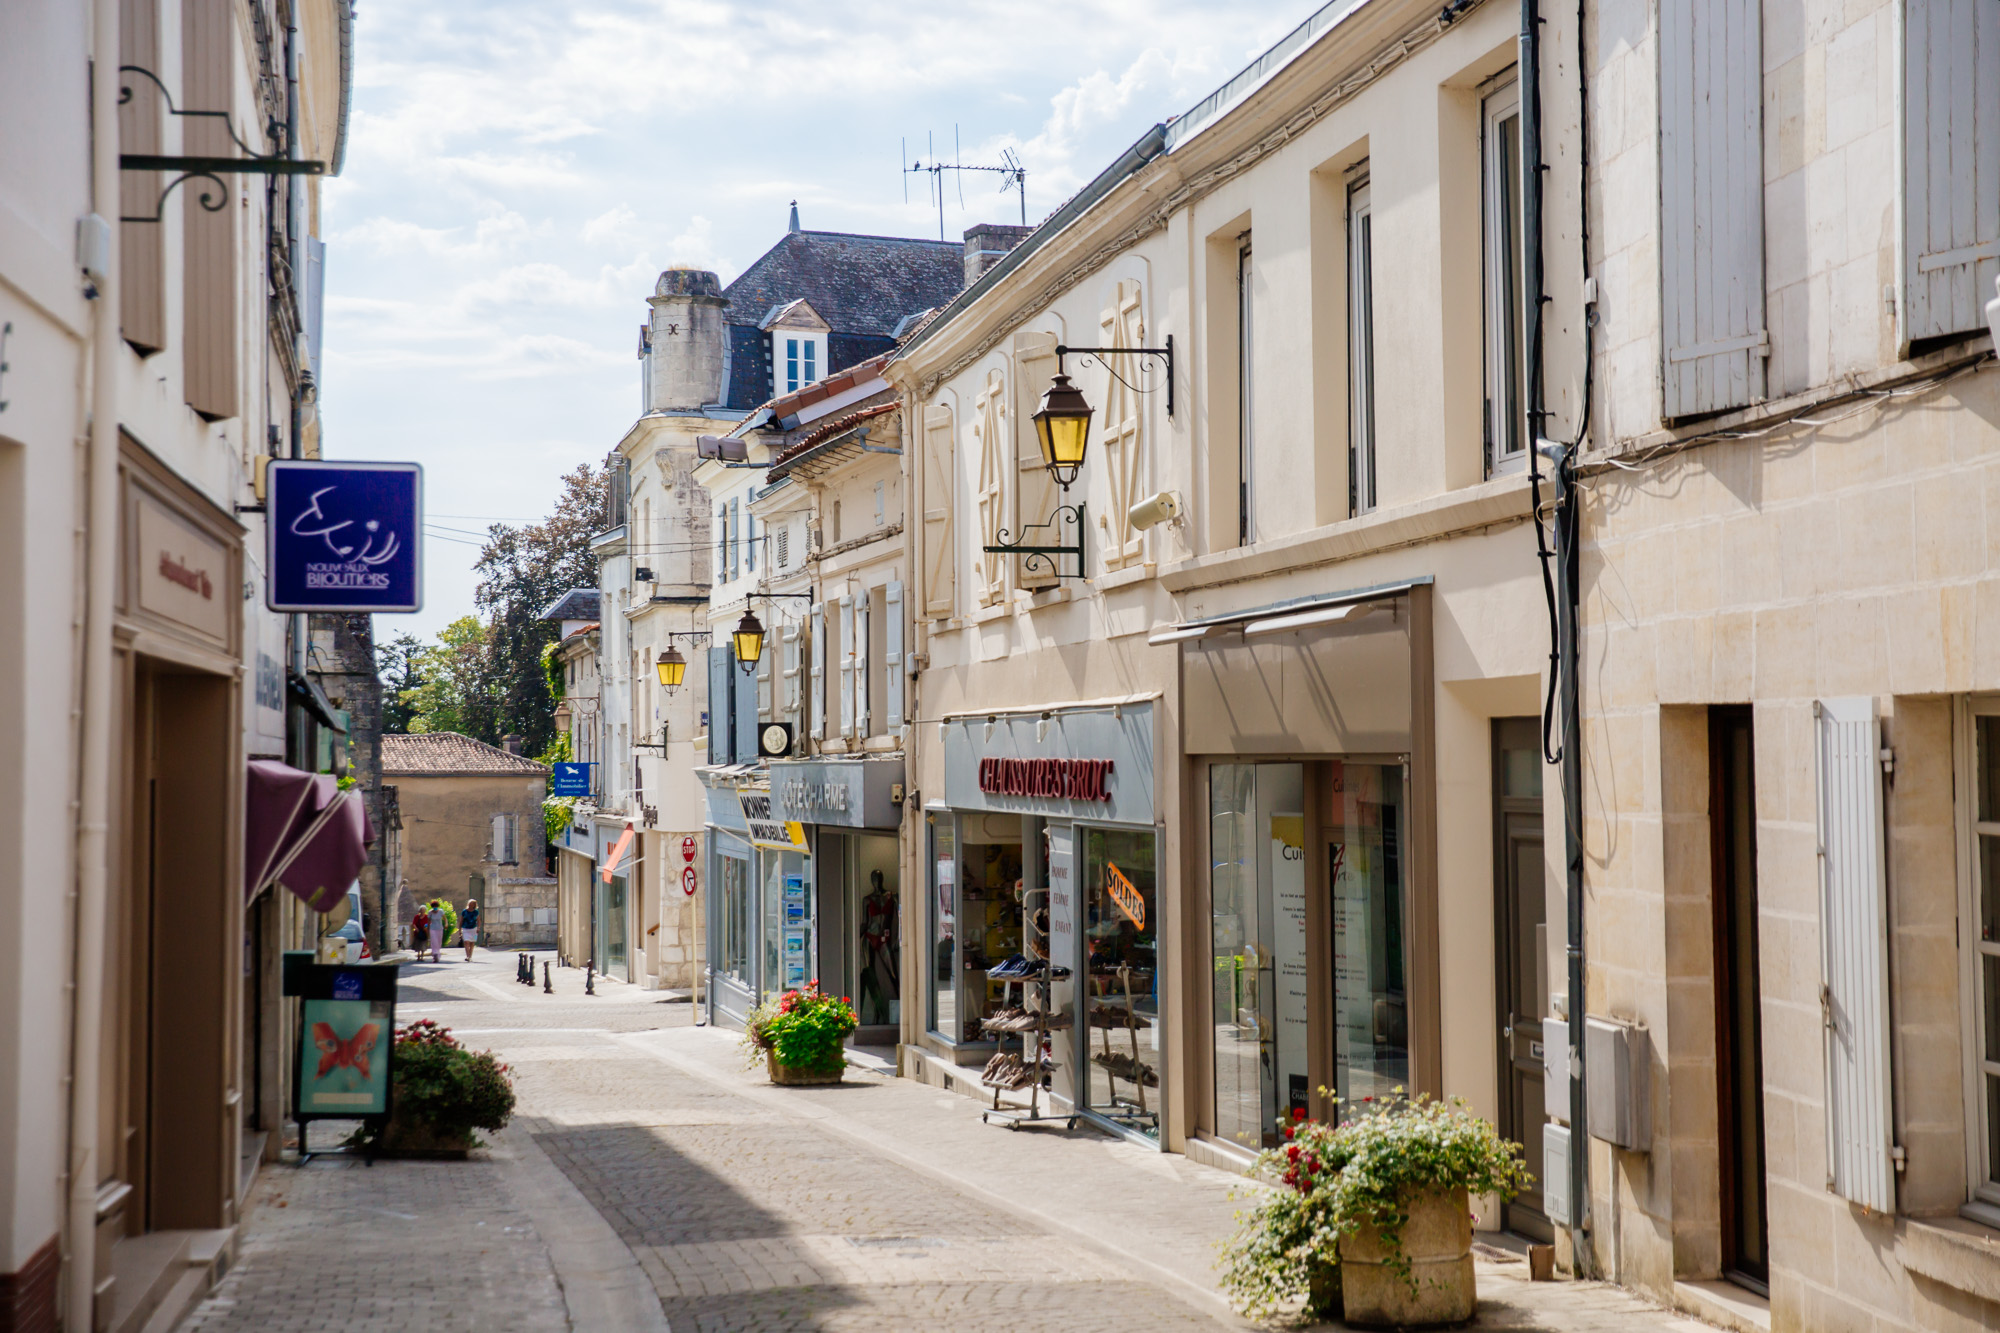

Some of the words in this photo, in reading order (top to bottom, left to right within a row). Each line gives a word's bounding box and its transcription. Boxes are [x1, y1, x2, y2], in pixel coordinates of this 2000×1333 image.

[979, 757, 1066, 798] CHAUSSURES
[1066, 758, 1113, 802] BROC
[804, 783, 846, 811] CHARME
[750, 823, 793, 843] IMMOBILIE
[683, 845, 694, 854] STOP
[1053, 892, 1069, 907] FEMME
[1107, 867, 1144, 924] SOLDES
[1055, 920, 1071, 935] ENFANT
